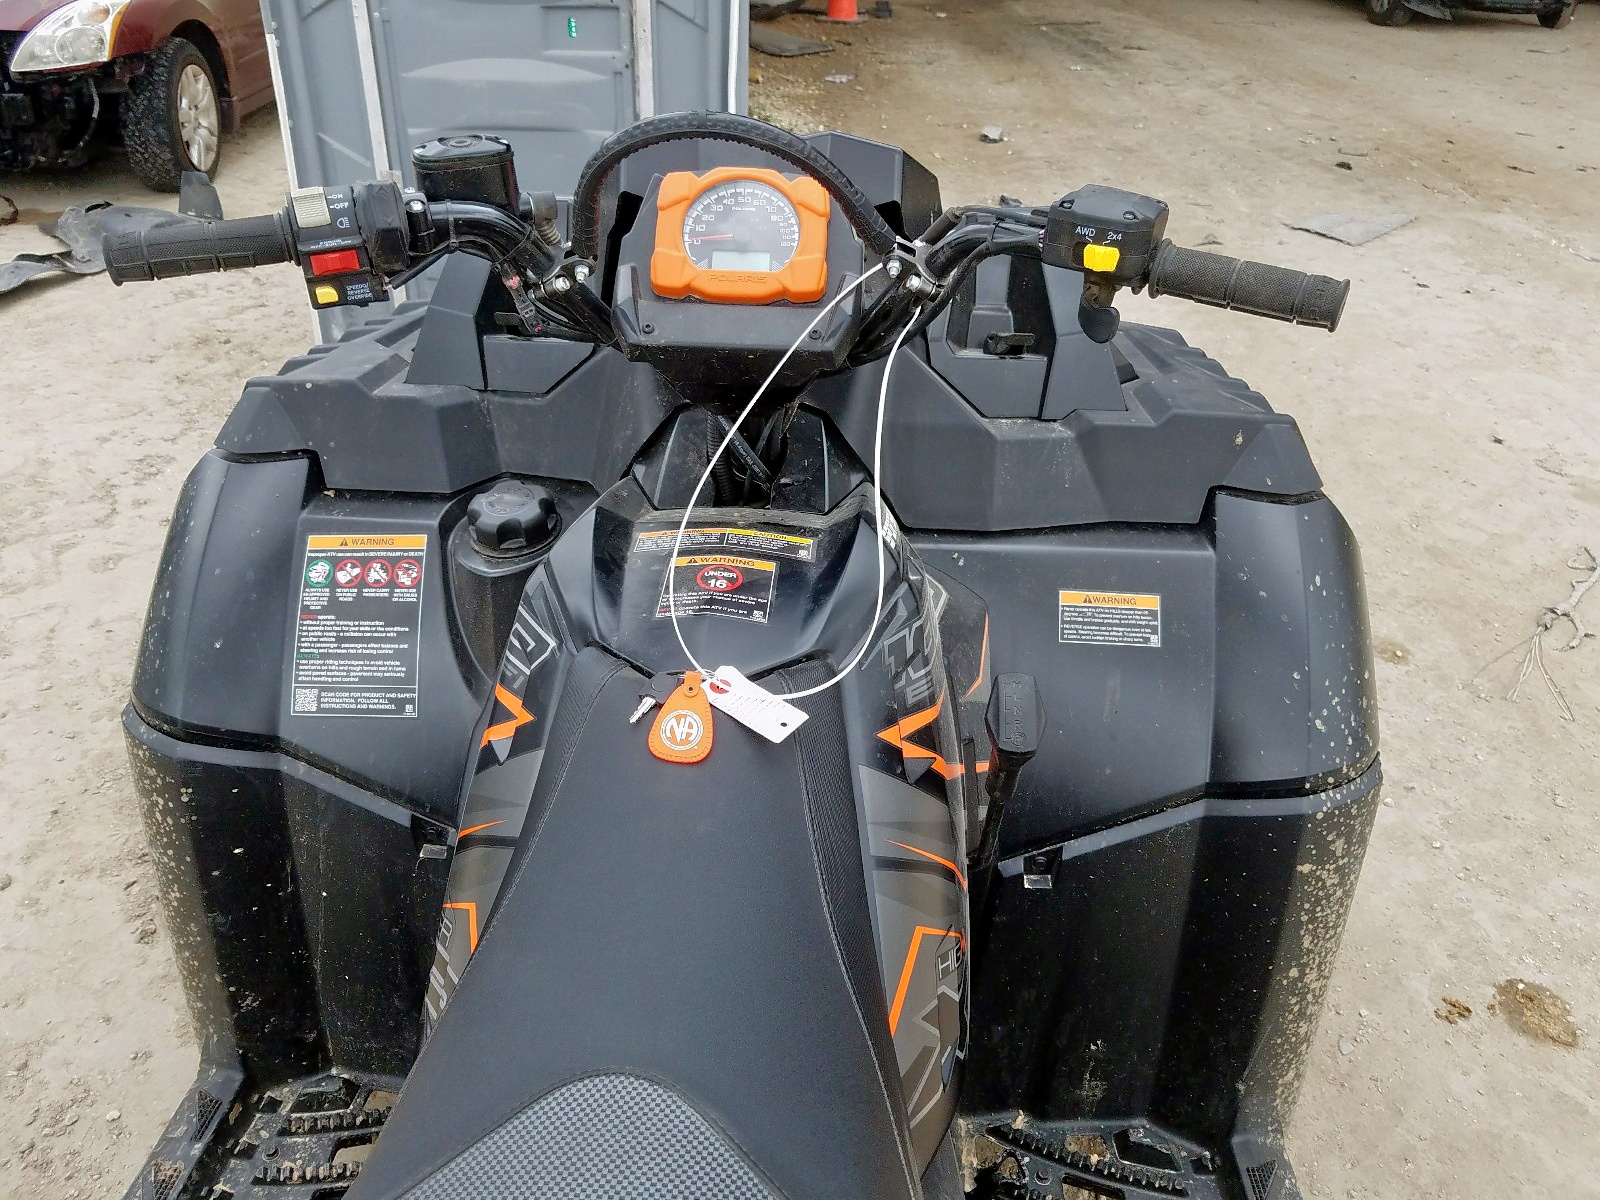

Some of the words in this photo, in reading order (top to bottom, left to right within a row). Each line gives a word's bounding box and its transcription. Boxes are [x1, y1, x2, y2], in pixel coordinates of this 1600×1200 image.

[1075, 226, 1096, 236] AWD
[1107, 232, 1122, 240] 2x4
[710, 274, 767, 283] POLARIS
[701, 557, 755, 567] WARNING
[708, 580, 727, 588] 16
[1093, 597, 1136, 605] WARNING
